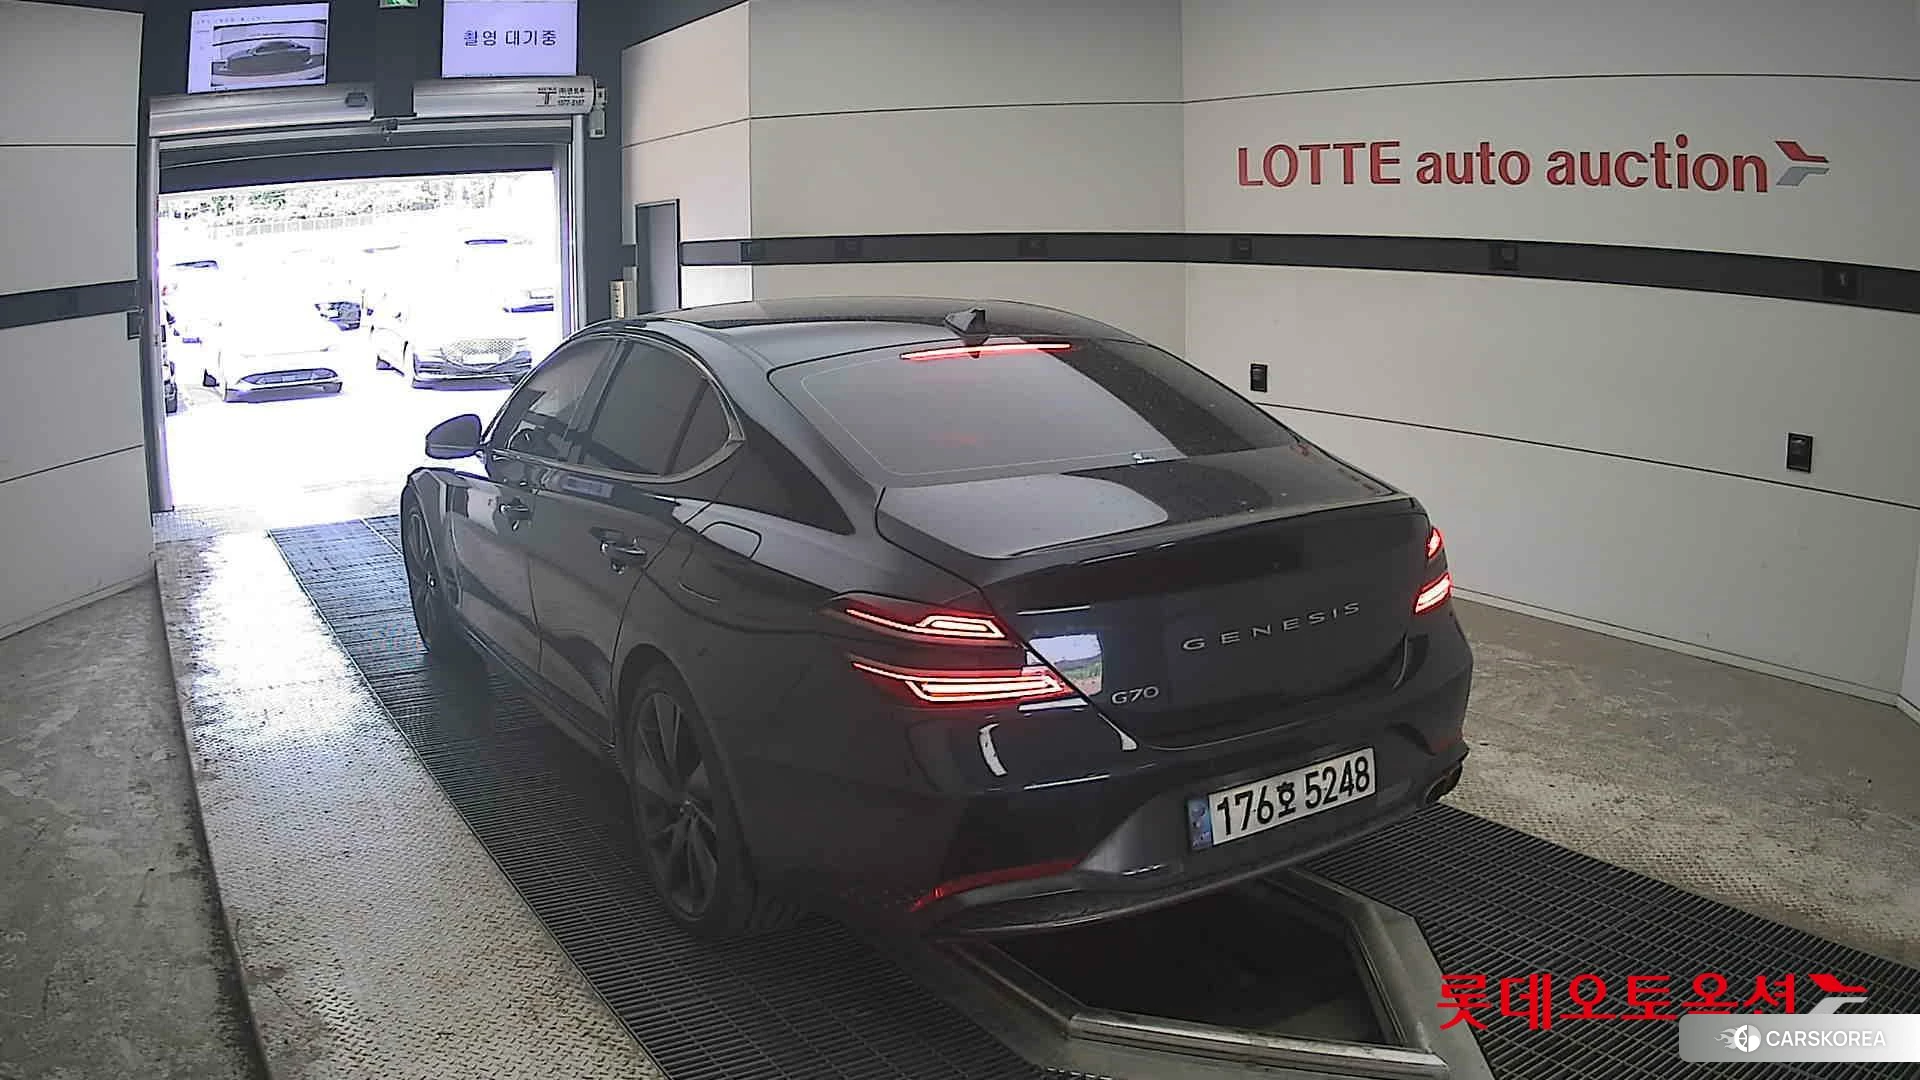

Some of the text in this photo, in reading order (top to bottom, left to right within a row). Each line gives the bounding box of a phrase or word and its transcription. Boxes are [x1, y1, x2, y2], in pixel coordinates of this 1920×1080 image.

[504, 29, 557, 47] 대기중
[1236, 133, 1769, 193] LOTTE auto auction
[1182, 601, 1361, 651] GENESIS
[1111, 685, 1160, 705] G70
[1303, 755, 1371, 810] 5248
